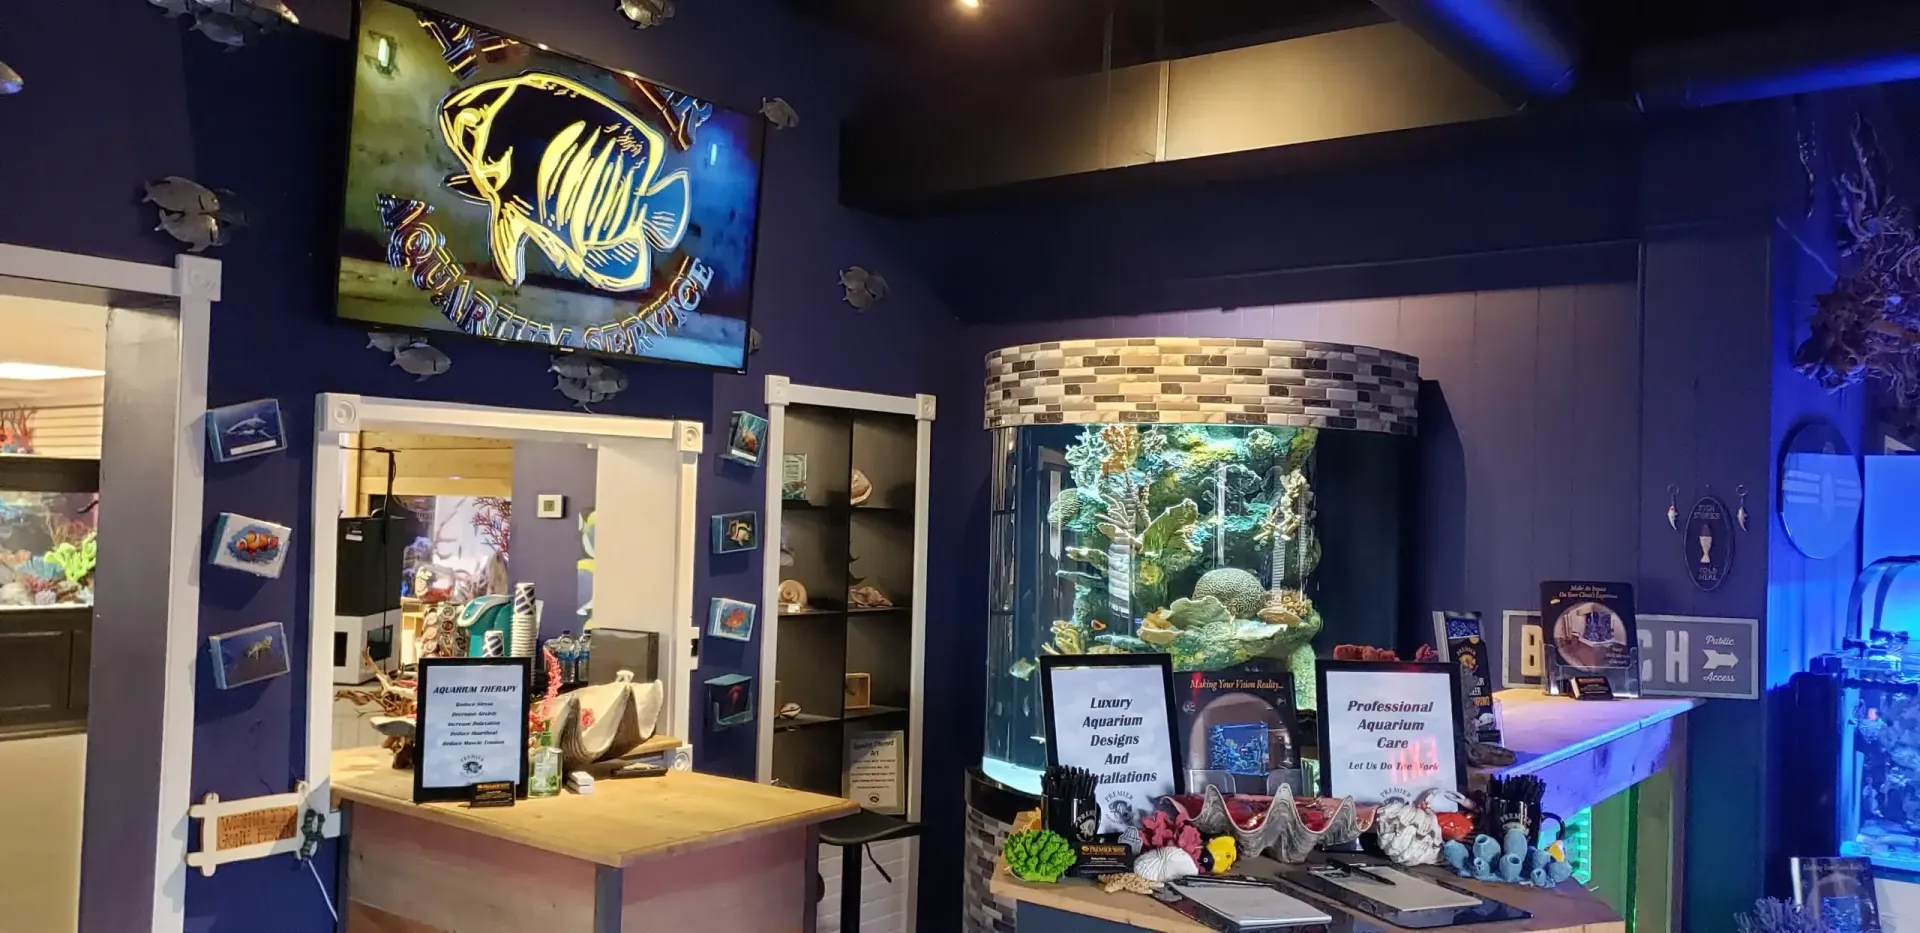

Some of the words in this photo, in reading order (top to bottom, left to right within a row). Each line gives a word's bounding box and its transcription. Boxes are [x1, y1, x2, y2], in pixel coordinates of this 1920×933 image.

[584, 256, 715, 355] SERVICE
[1705, 634, 1735, 647] Public
[1703, 671, 1736, 682] Access
[433, 685, 478, 695] AQUARIUM
[479, 685, 518, 693] THERAPY
[1189, 679, 1218, 692] Making
[1218, 679, 1235, 689] Your
[1235, 679, 1256, 689] Vision
[1257, 679, 1284, 691] Reality...
[1090, 697, 1133, 710] Luxury
[1347, 700, 1434, 712] Professional
[1082, 714, 1143, 730] Aquarium
[1357, 718, 1425, 732] Aquarium
[1090, 733, 1140, 748] Designs
[1377, 736, 1409, 749] Care
[1104, 752, 1130, 765] And
[1348, 761, 1364, 770] Let
[1366, 761, 1377, 770] Us
[1380, 762, 1392, 770] Do
[1104, 790, 1134, 803] PREMIER
[1380, 786, 1412, 798] PREMIER
